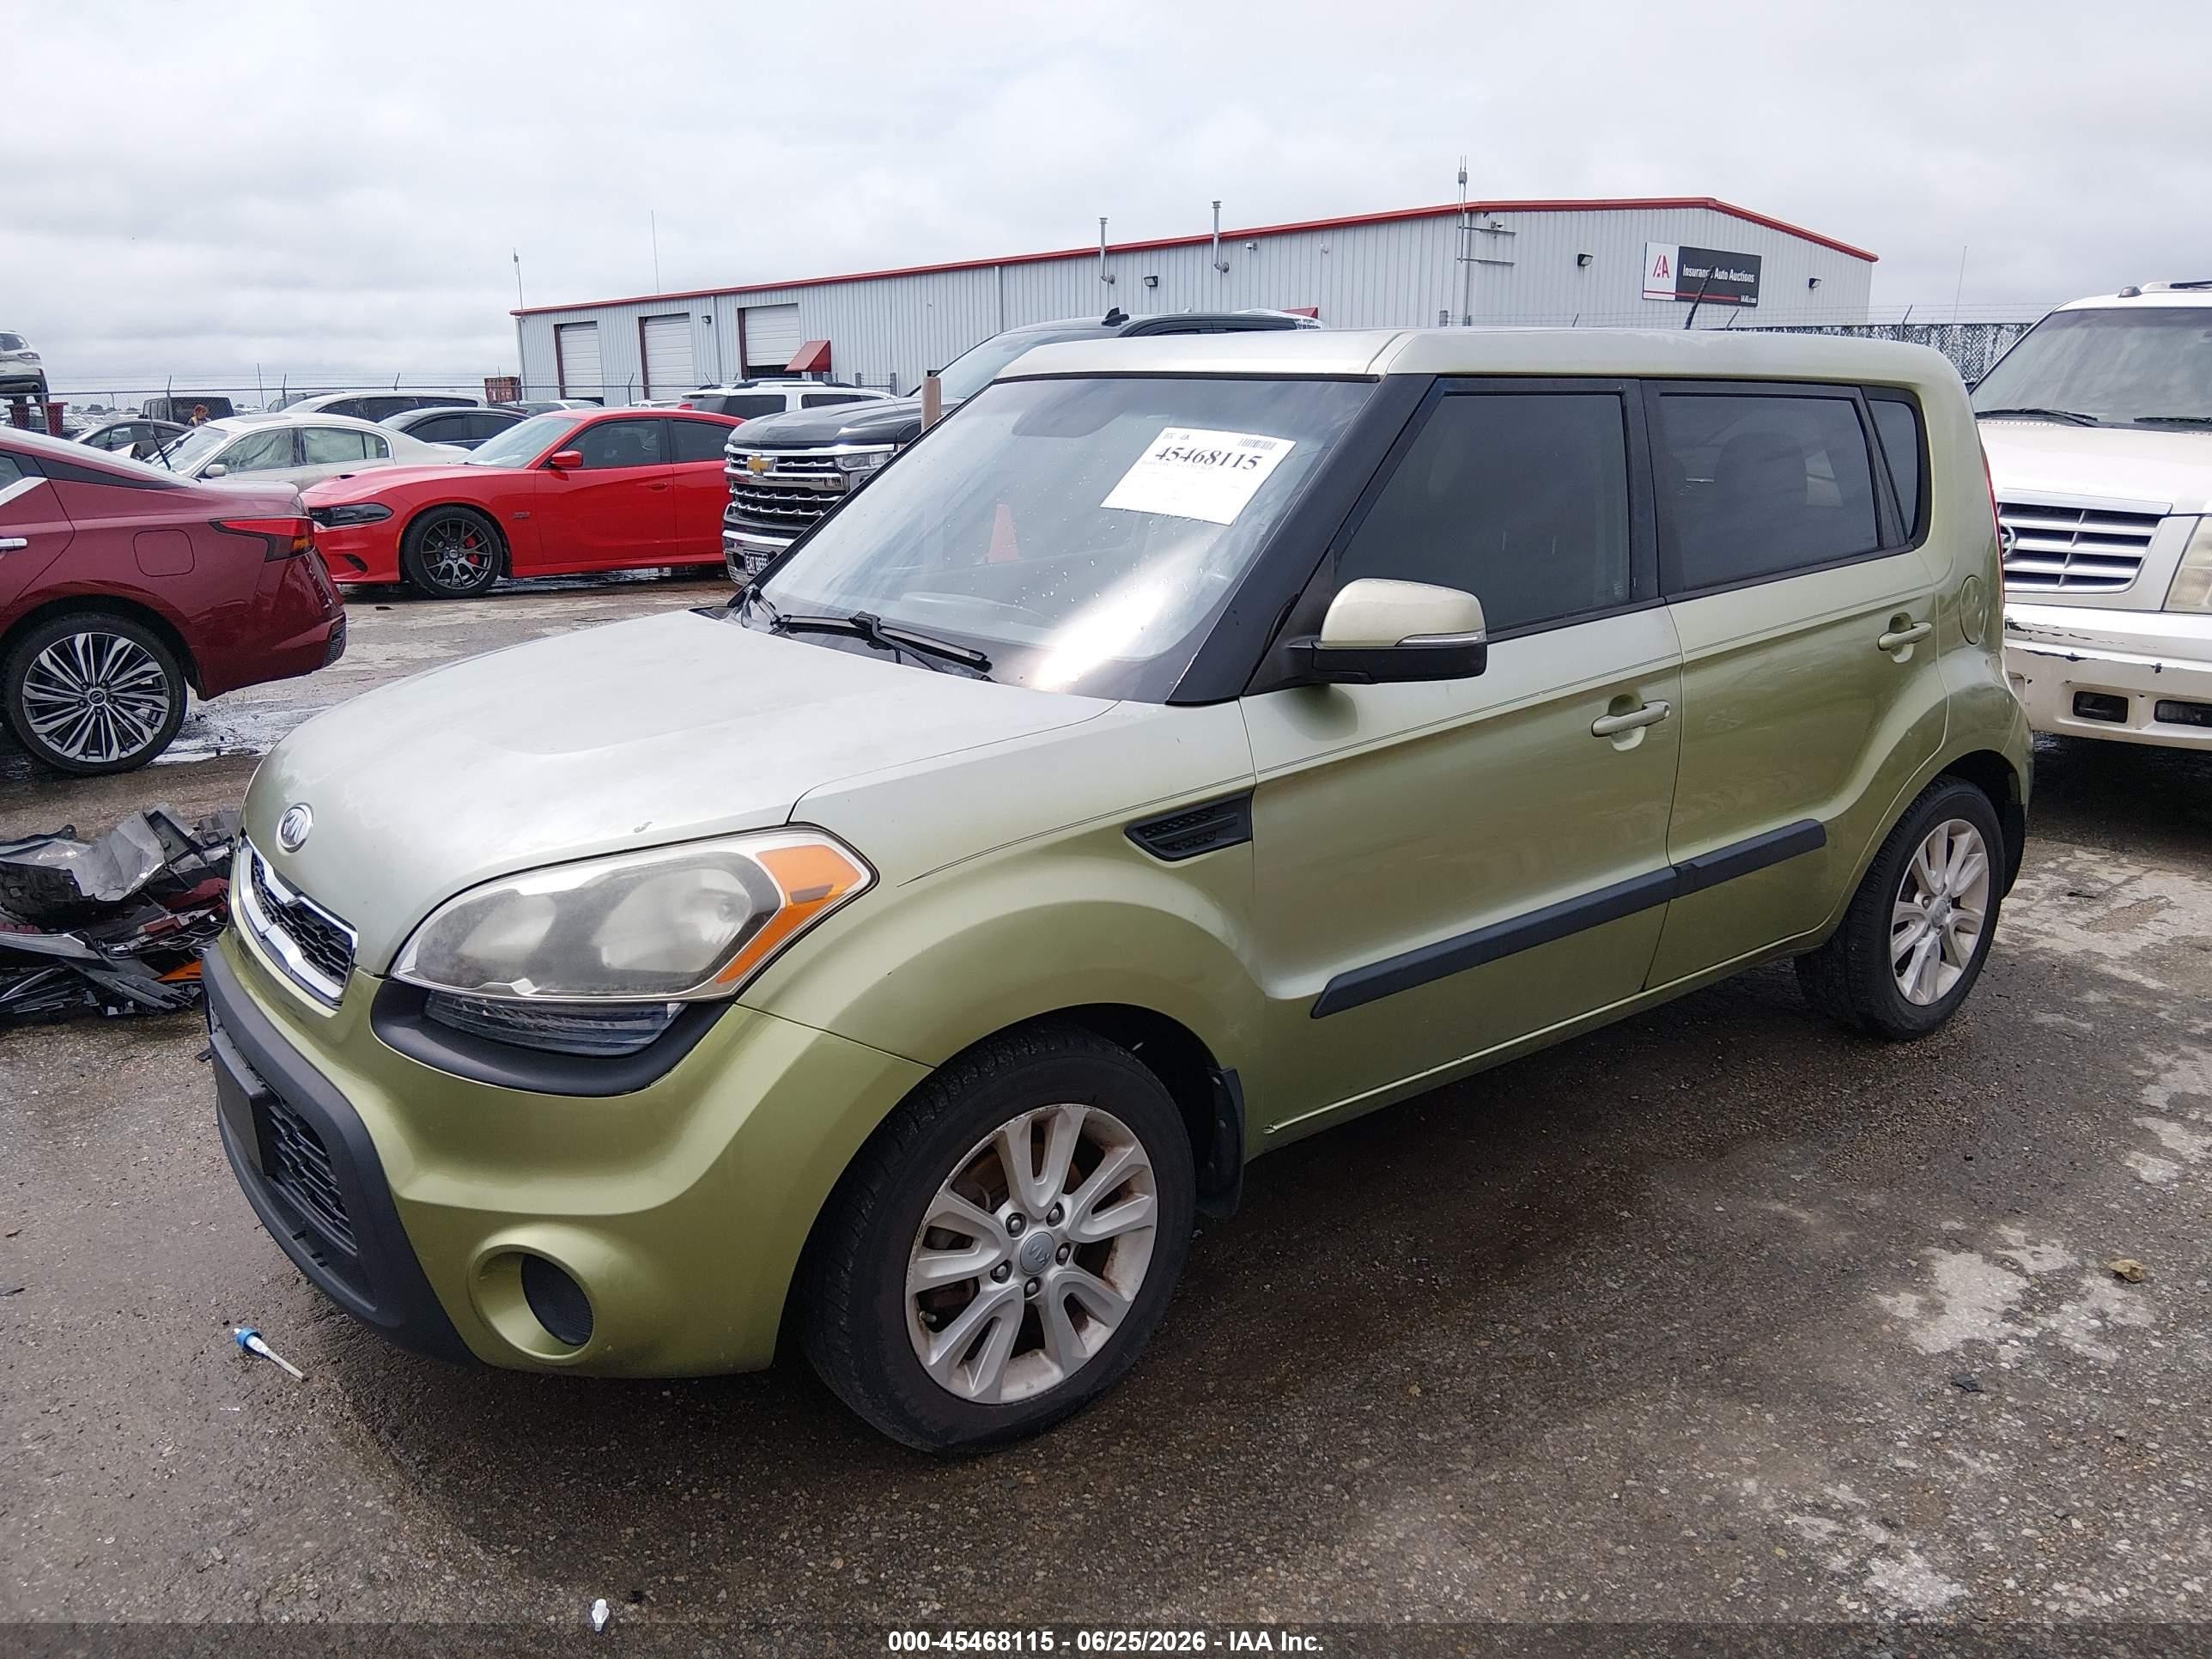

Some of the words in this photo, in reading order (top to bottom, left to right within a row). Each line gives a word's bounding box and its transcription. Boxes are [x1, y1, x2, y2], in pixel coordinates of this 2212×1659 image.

[1683, 264, 1713, 278] Insuranc
[1714, 267, 1729, 280] Auto
[1729, 269, 1755, 283] Auctions
[1155, 447, 1263, 470] 45468115
[745, 555, 755, 569] EAT
